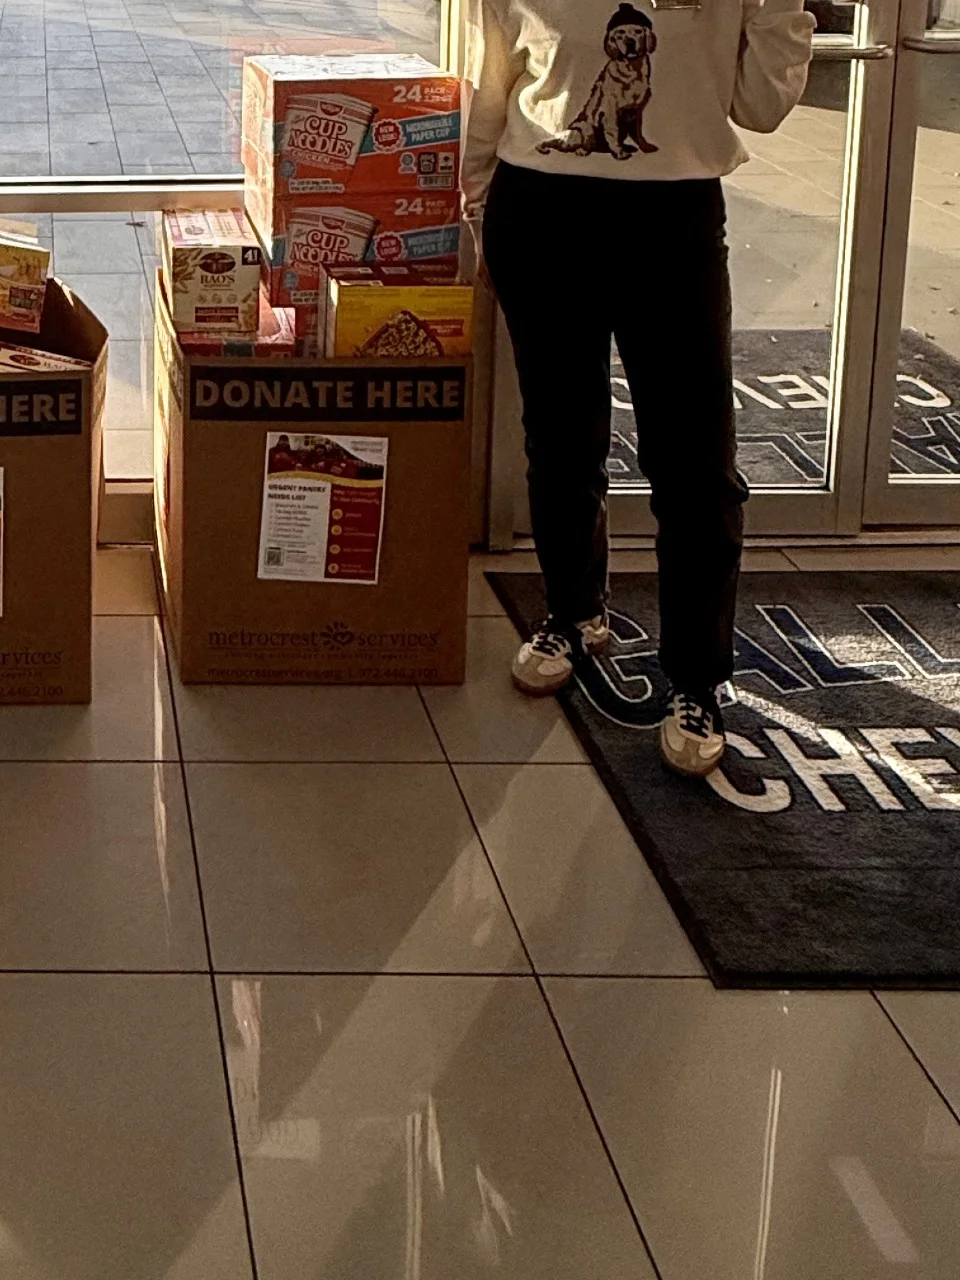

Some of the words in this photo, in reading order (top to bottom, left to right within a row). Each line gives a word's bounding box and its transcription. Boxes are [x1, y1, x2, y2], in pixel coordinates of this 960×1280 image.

[392, 84, 422, 103] 24
[304, 115, 348, 139] CUP
[288, 128, 354, 158] NOODLES
[292, 149, 330, 165] CHICKEN
[394, 197, 423, 216] 24
[307, 229, 350, 250] CUP
[293, 261, 320, 272] CHICK
[200, 274, 235, 285] RAO'S
[194, 379, 355, 410] DONATE
[366, 379, 460, 410] HERE
[208, 628, 317, 647] metrocrest
[358, 628, 438, 647] services
[571, 604, 960, 729] GALL
[704, 726, 960, 813] CHE
